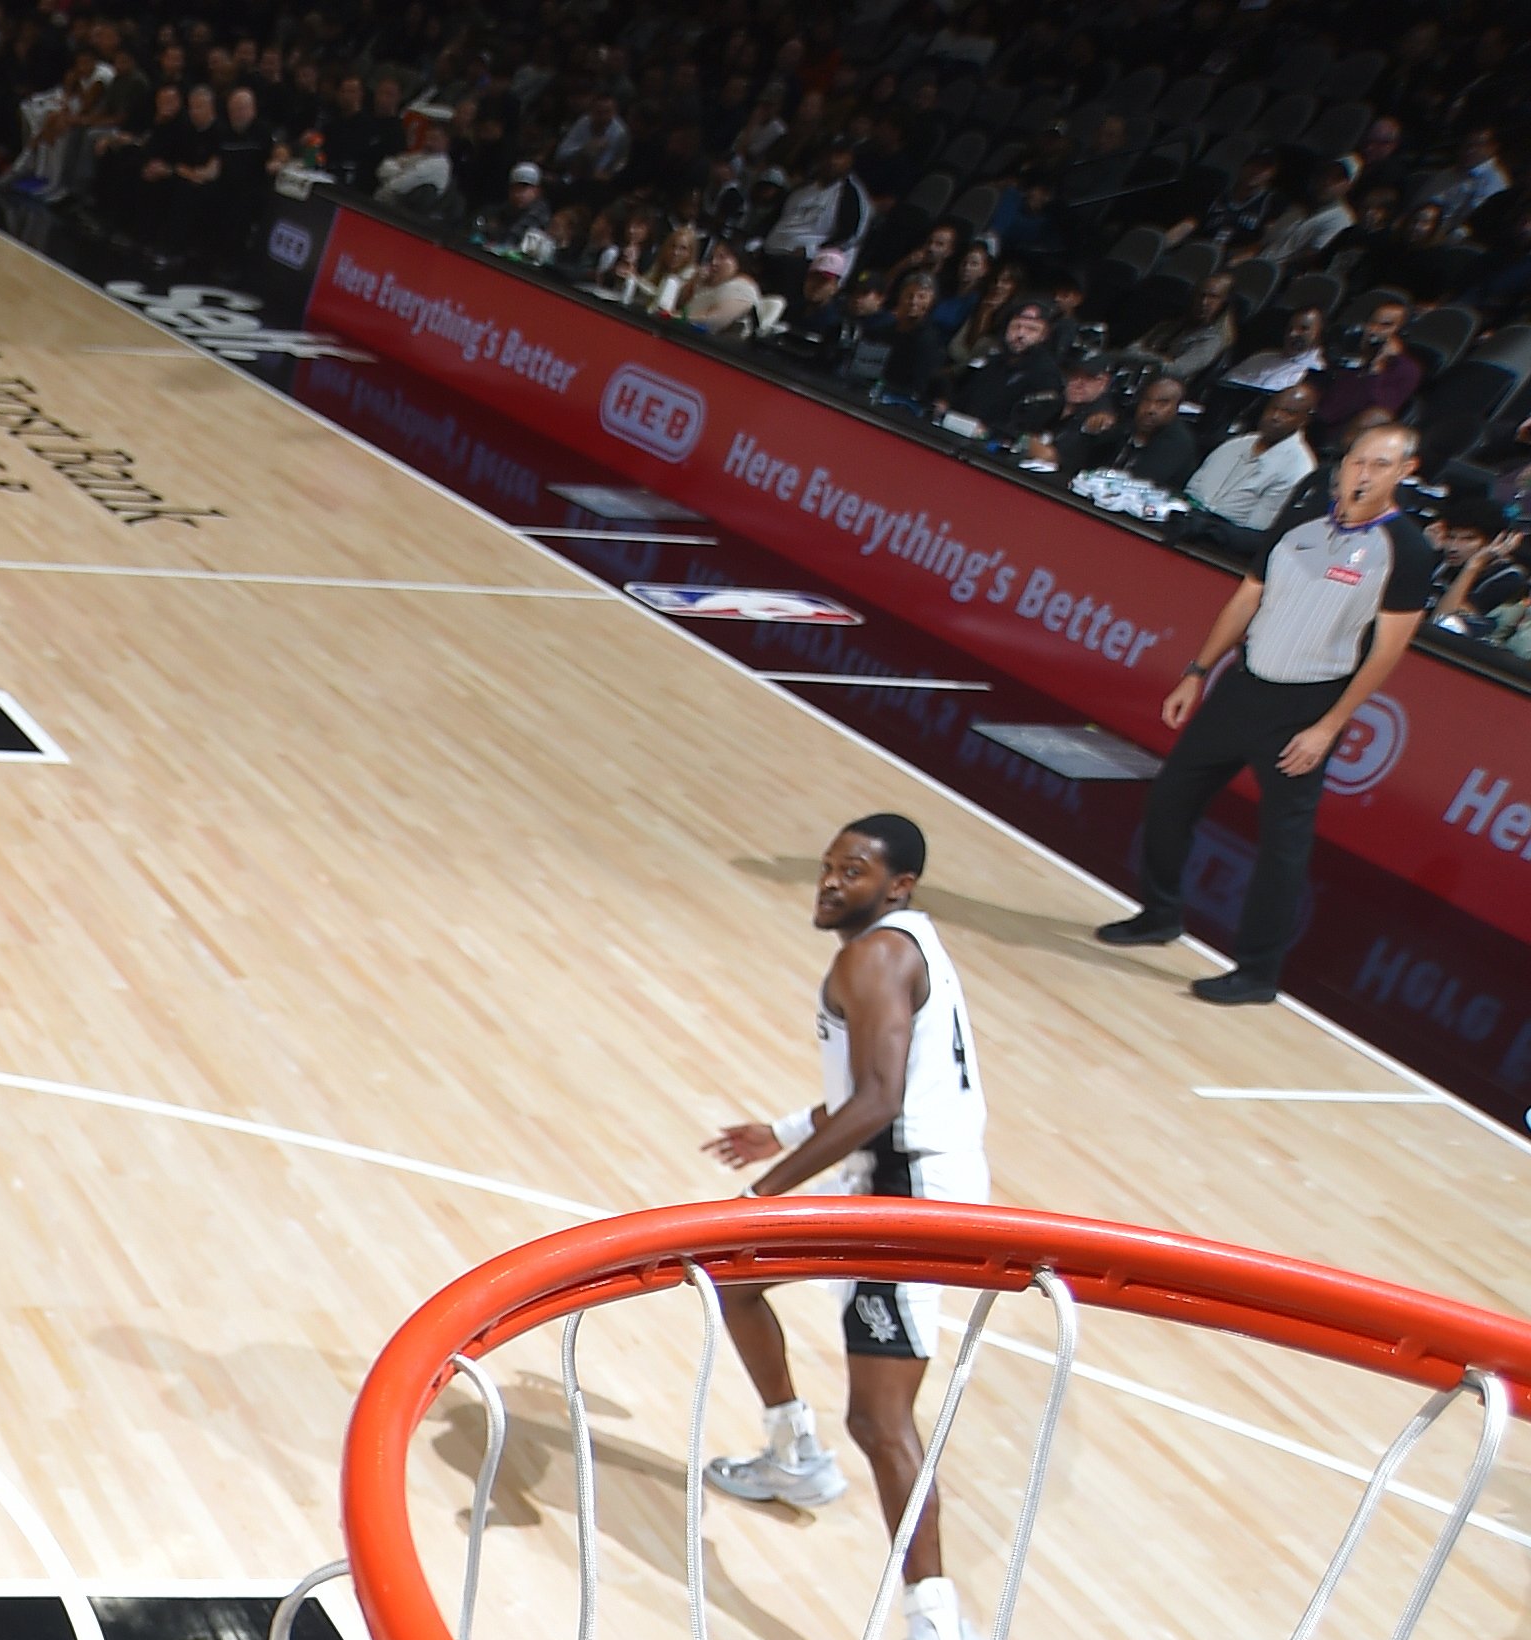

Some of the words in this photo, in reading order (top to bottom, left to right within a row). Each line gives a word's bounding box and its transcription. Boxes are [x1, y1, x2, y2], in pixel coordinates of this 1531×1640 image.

[499, 327, 577, 395] Better
[28, 443, 229, 527] Bank
[723, 432, 800, 500] Here
[800, 466, 1017, 603] Everything's
[1015, 568, 1160, 669] Better
[1442, 767, 1531, 861] He
